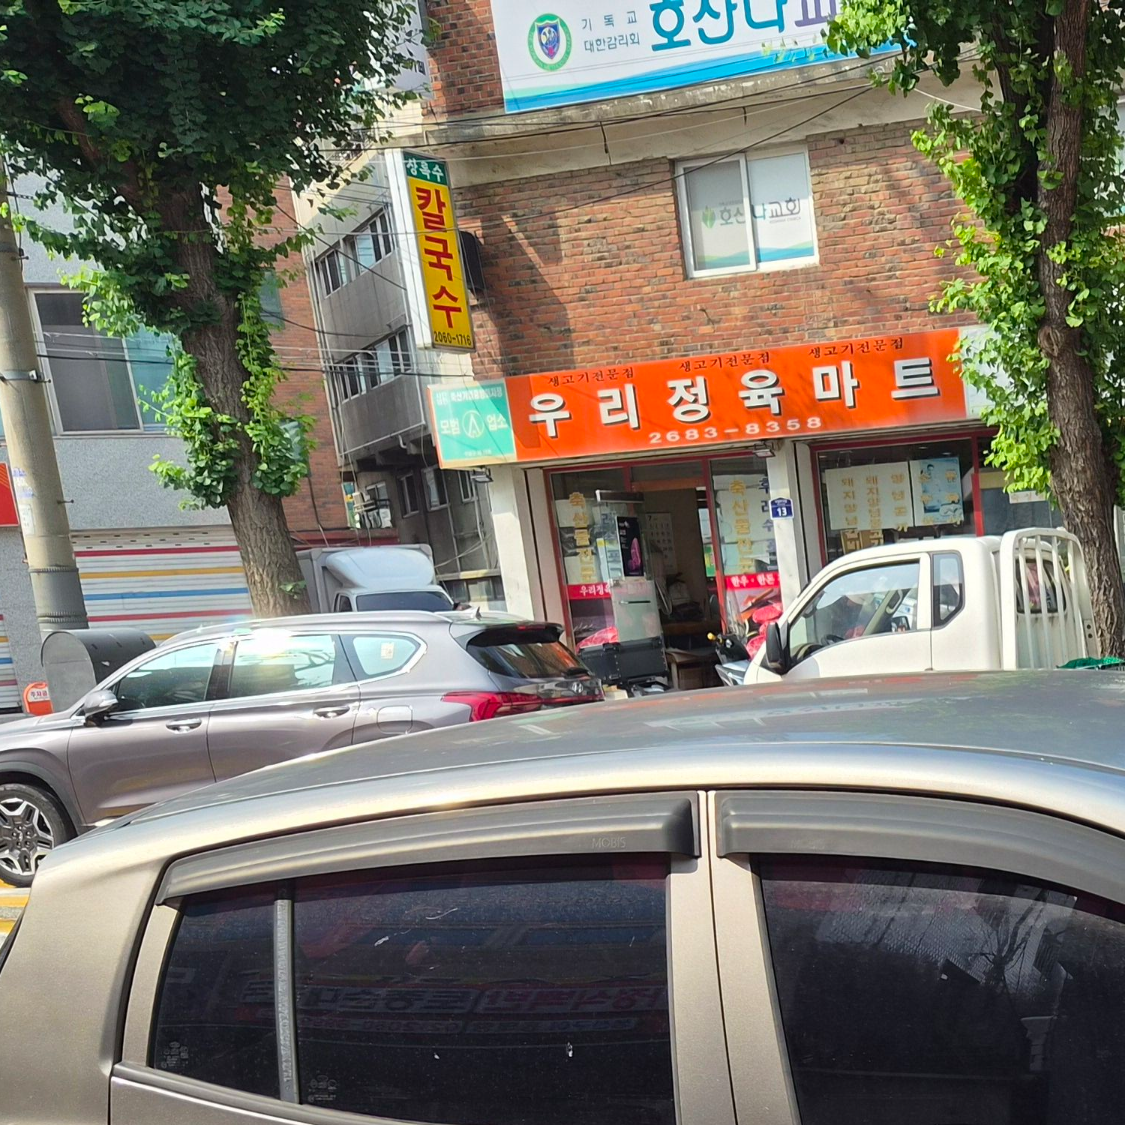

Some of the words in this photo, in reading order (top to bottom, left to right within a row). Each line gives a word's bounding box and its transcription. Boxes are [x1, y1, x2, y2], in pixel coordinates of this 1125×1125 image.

[584, 32, 640, 53] 대한감리회
[415, 186, 462, 329] 칼국수
[434, 330, 472, 347] 2060-1716
[808, 337, 904, 359] 생고기전문점
[679, 351, 770, 373] 생고기전문점
[547, 367, 634, 387] 생고기전문점
[529, 357, 940, 438] 우리정육마트
[649, 416, 822, 444] 2683-8358
[776, 507, 787, 517] 13
